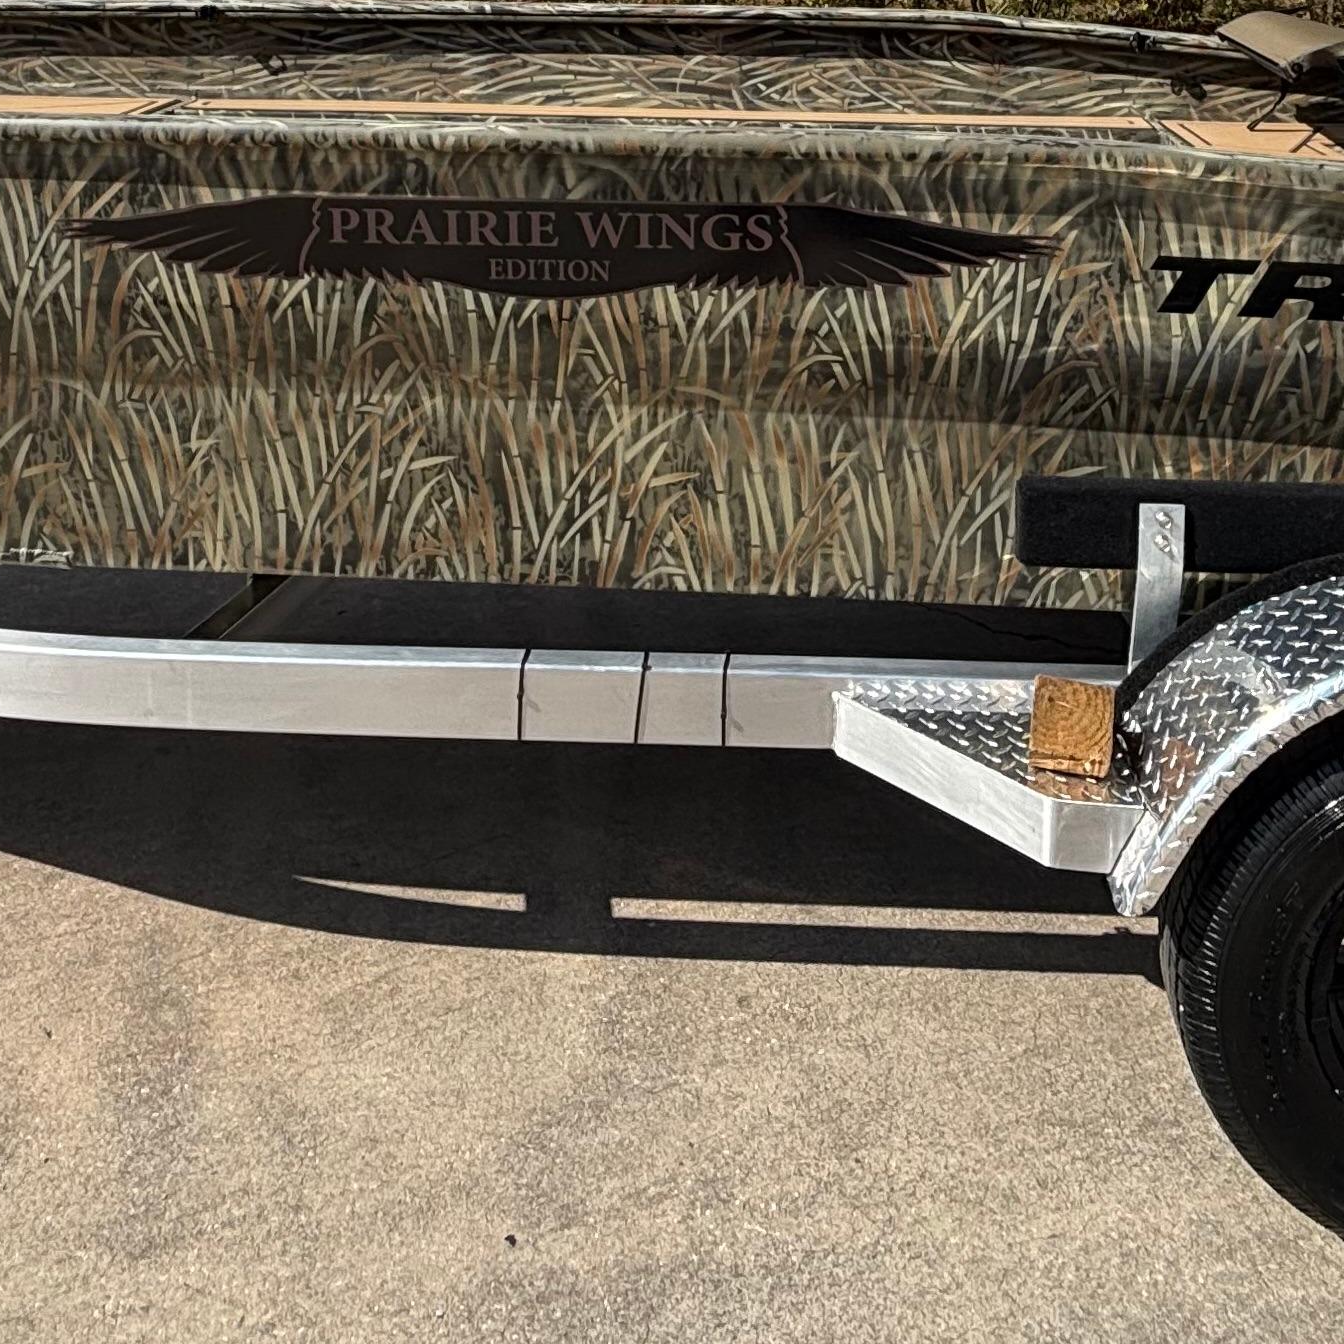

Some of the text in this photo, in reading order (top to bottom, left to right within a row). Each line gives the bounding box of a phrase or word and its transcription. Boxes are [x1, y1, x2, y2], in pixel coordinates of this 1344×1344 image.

[327, 206, 775, 252] PRAIRIE WINGS
[488, 257, 612, 283] EDITION
